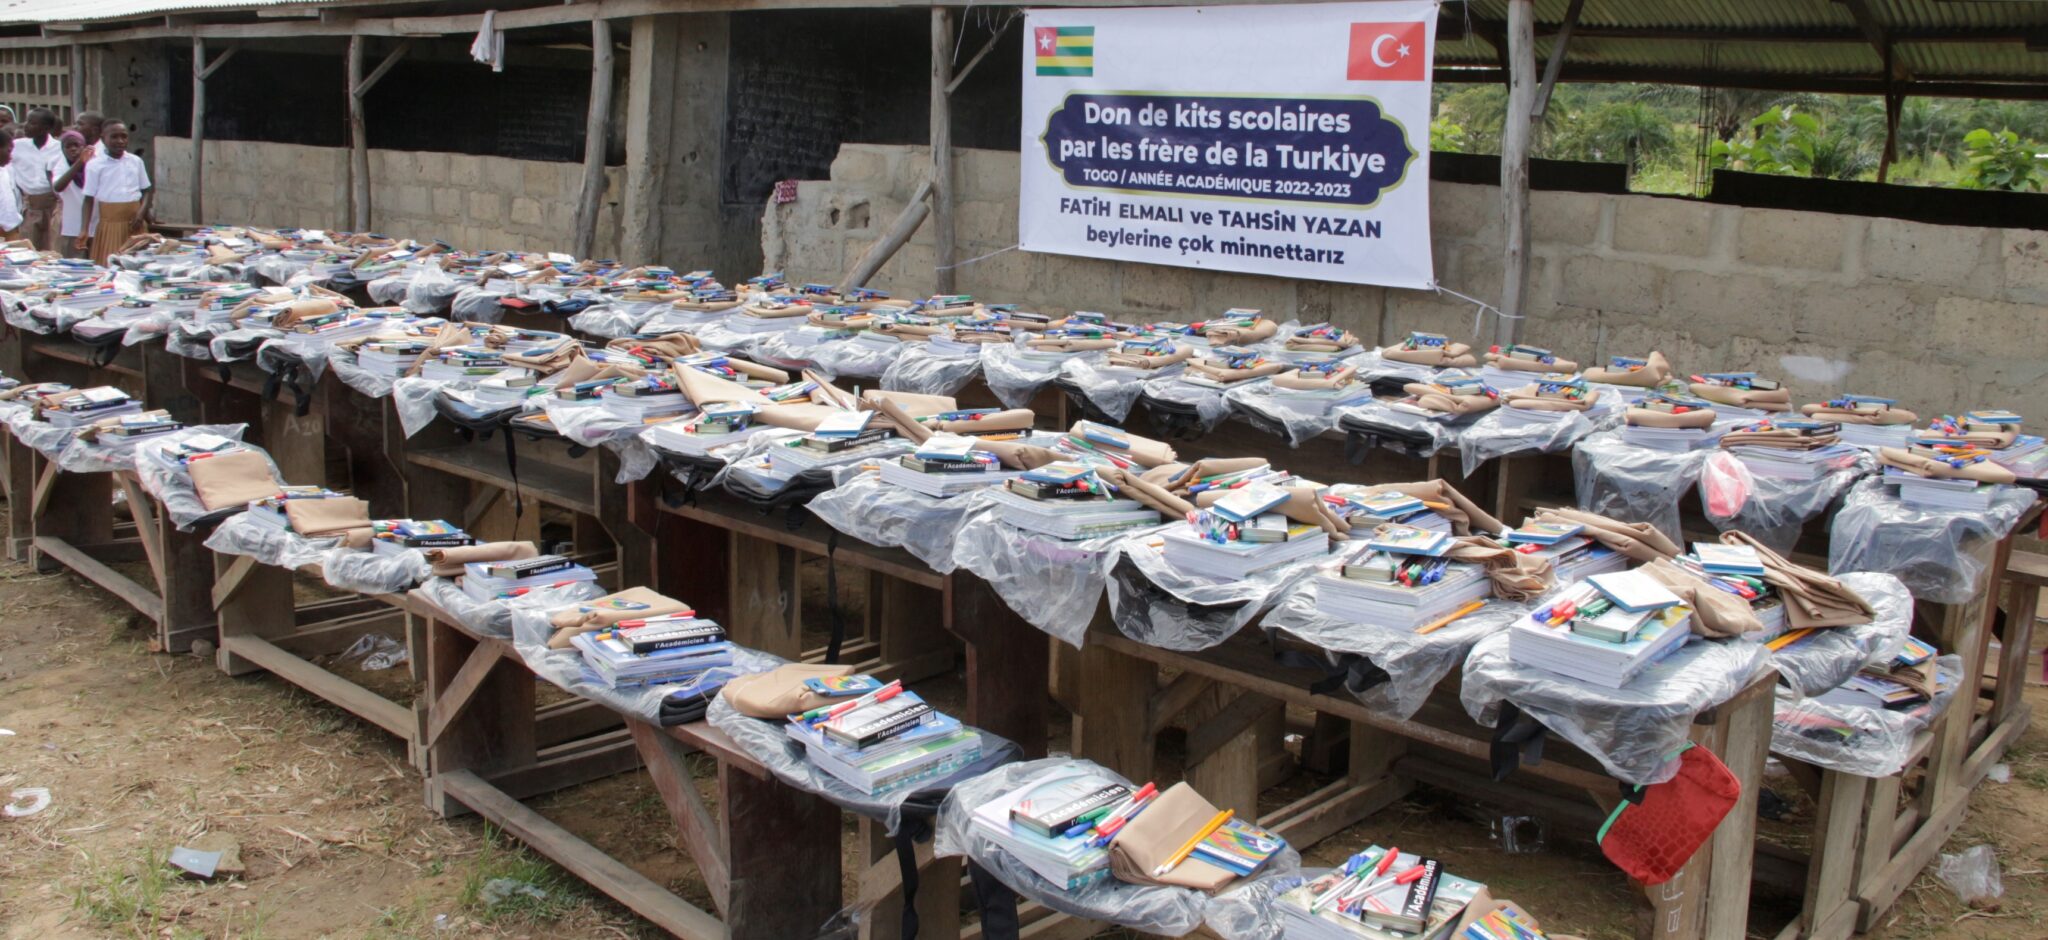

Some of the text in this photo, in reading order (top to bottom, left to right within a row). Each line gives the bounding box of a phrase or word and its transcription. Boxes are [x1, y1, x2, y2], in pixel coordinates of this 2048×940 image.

[1084, 102, 1351, 133] Don de kits scolaires
[1060, 136, 1386, 179] par les frère de la Turkiye
[1083, 168, 1351, 198] TOGO / ANNÉE ACADÉMIQUE 2022-2023
[1119, 203, 1183, 223] ELMALI
[1190, 211, 1213, 226] ve
[1303, 216, 1381, 239] YAZAN
[1087, 225, 1344, 265] beylerine çok minnettarız
[1041, 784, 1126, 824] l'Académicien
